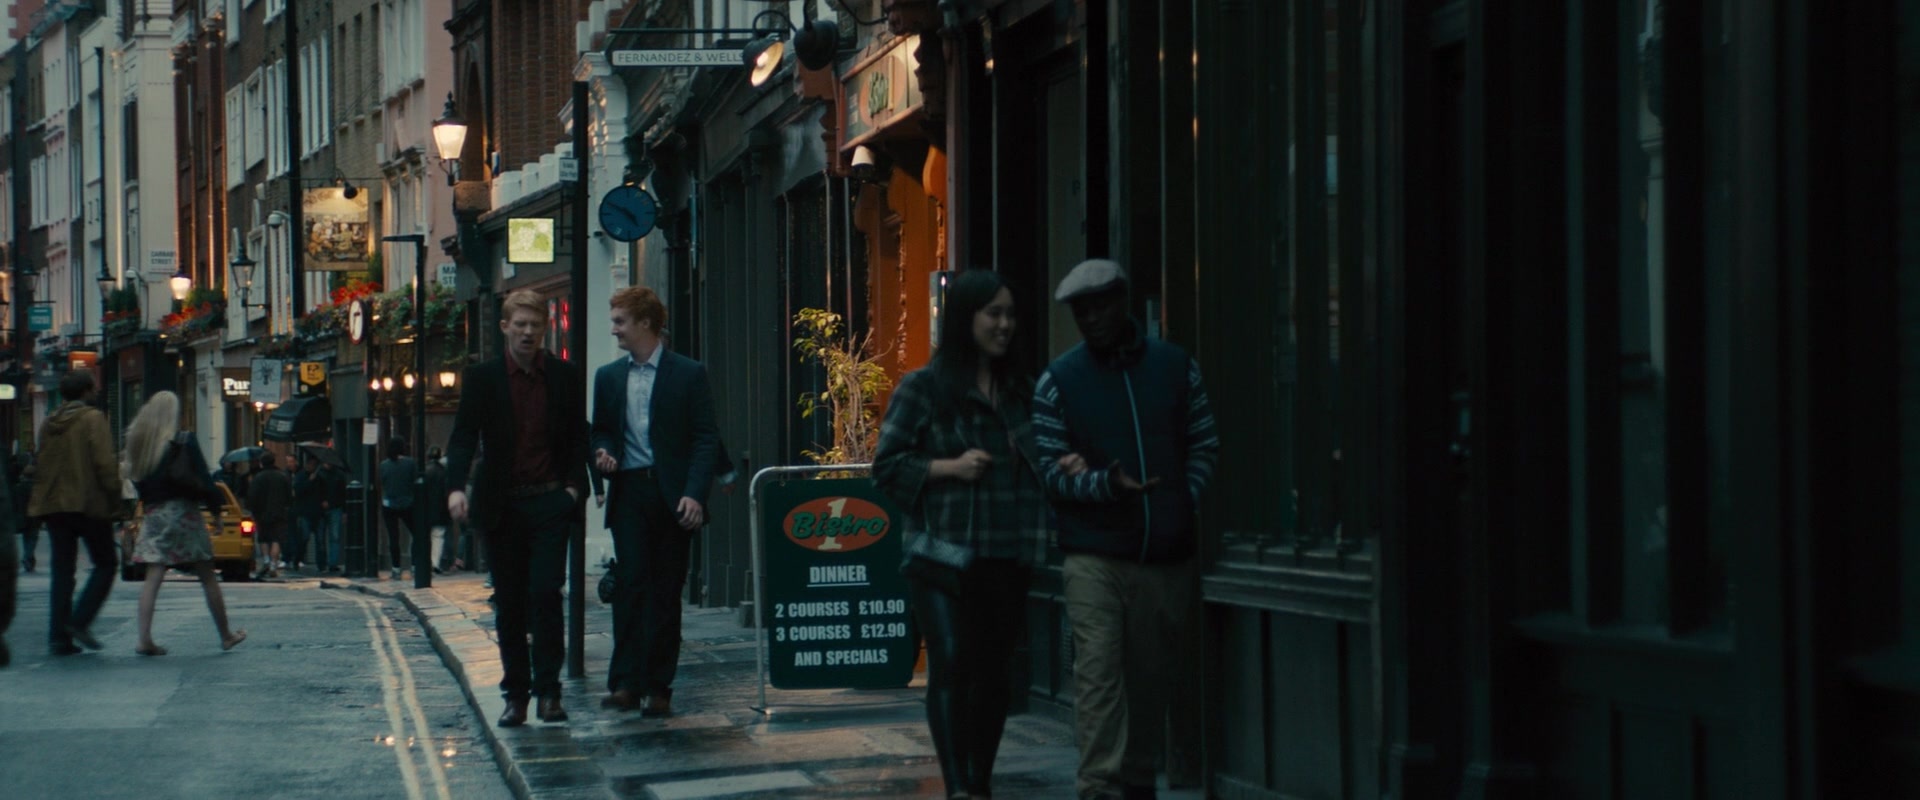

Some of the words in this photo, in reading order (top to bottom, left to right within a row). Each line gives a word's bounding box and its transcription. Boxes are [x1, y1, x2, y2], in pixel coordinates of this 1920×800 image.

[618, 53, 690, 62] FERNANDEZ
[694, 53, 702, 62] &
[792, 512, 886, 538] Bistro
[809, 565, 867, 583] DINNER
[775, 603, 784, 618] 2
[788, 601, 849, 617] COURSES
[859, 599, 905, 615] £10.90
[776, 627, 785, 641] 3
[789, 625, 850, 641] COURSES
[861, 623, 906, 638] £12.90
[794, 652, 822, 666] AND
[826, 649, 888, 665] SPECIALS
